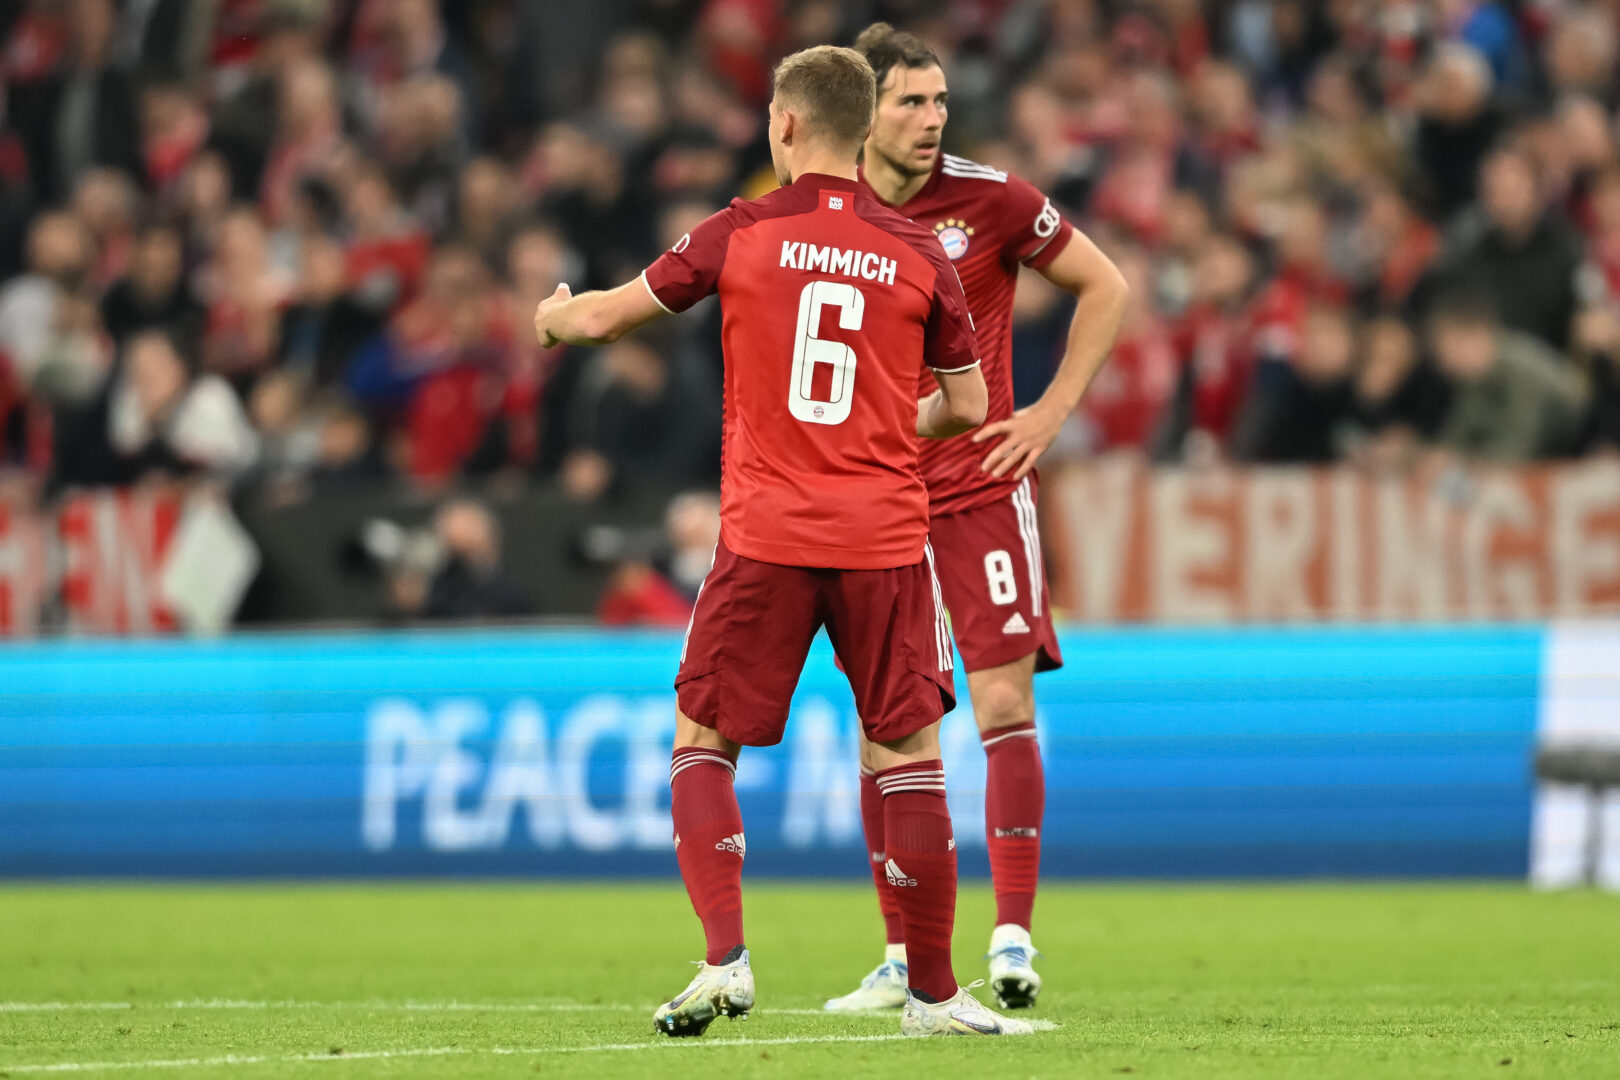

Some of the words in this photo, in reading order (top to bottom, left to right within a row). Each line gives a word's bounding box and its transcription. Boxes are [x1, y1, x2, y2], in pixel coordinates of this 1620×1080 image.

[780, 241, 897, 285] KIMMICH
[788, 281, 865, 425] 6
[984, 549, 1018, 605] 8
[364, 698, 675, 851] PEACE
